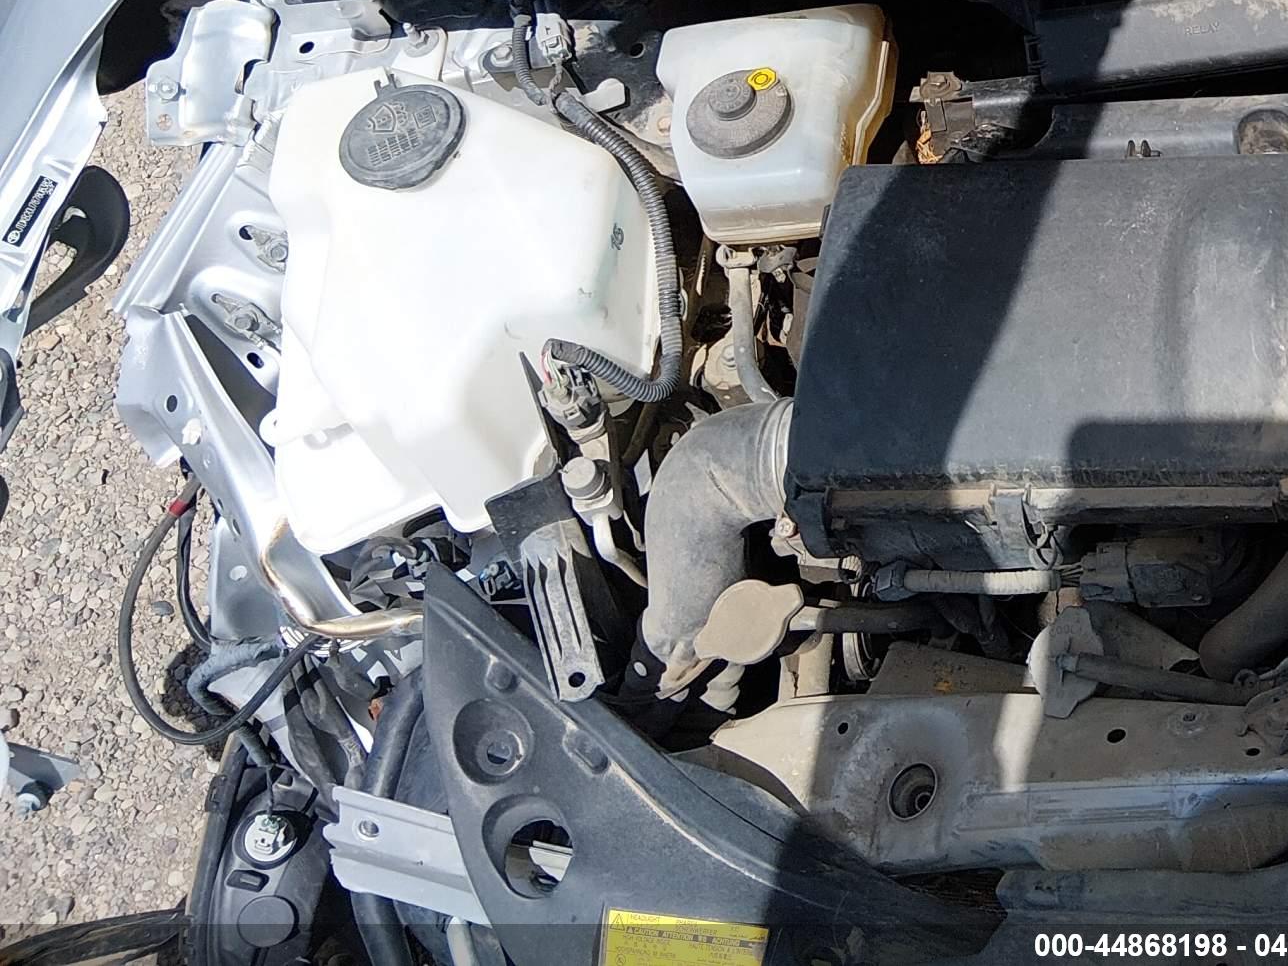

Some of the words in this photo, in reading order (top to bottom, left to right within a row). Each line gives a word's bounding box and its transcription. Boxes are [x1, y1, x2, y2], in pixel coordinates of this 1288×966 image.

[1184, 20, 1220, 36] RELAY
[634, 926, 658, 937] CAUTION
[662, 931, 694, 941] ATTENTION
[712, 937, 740, 947] ACHTUNG
